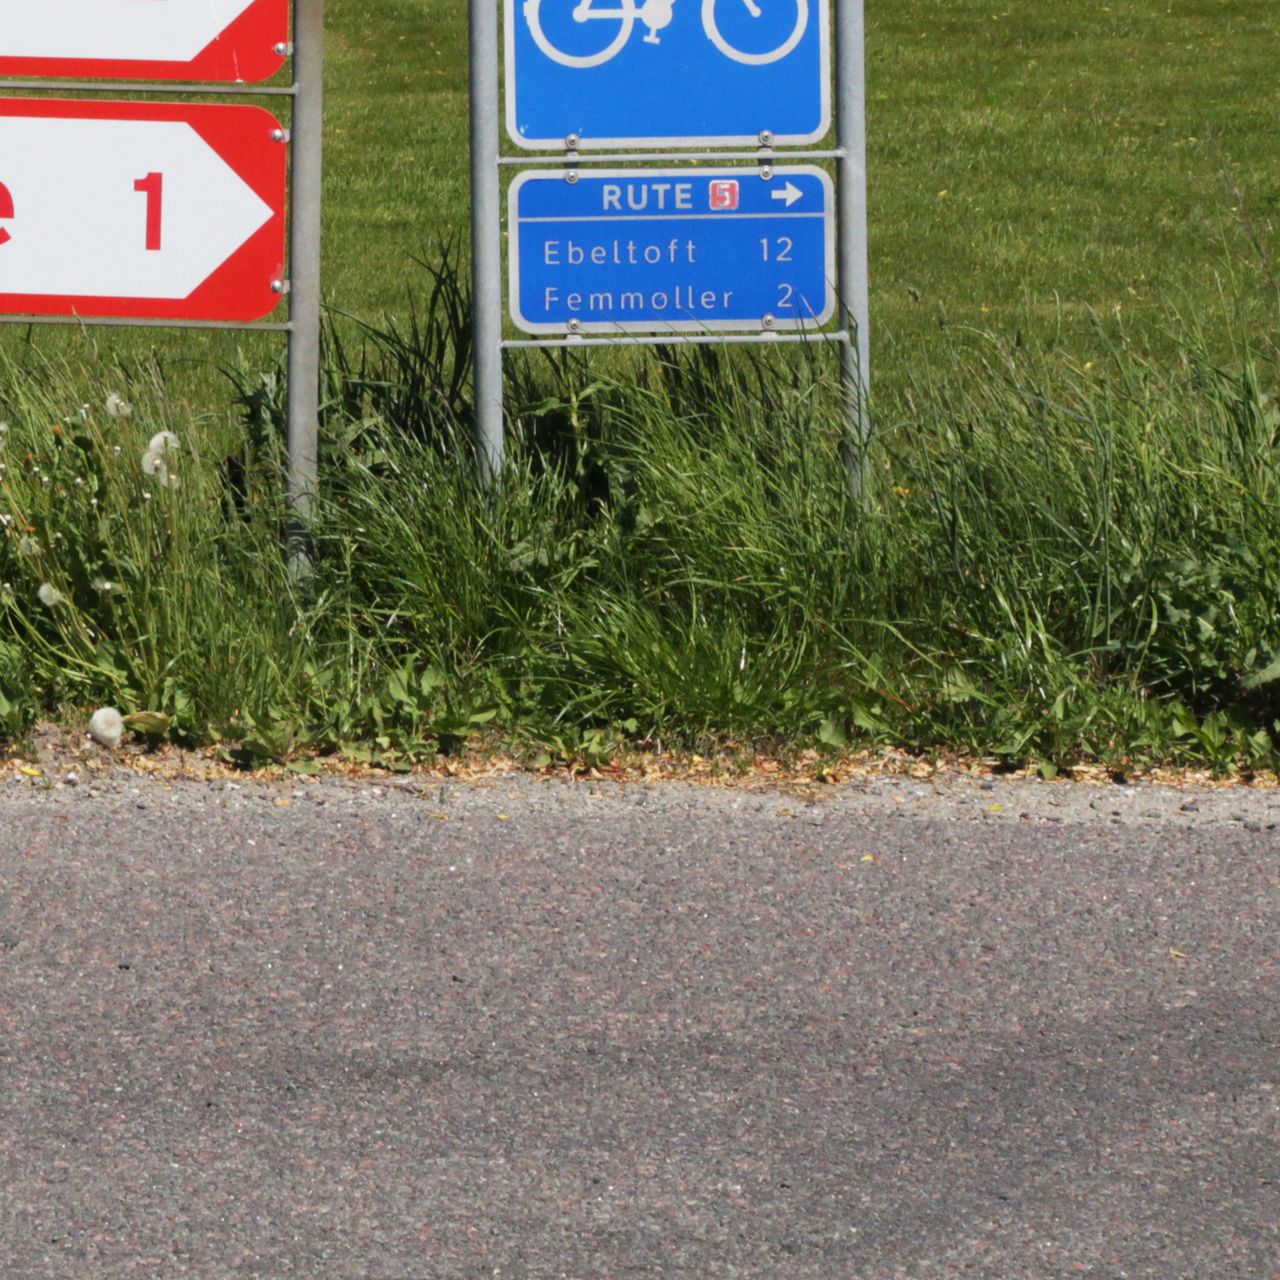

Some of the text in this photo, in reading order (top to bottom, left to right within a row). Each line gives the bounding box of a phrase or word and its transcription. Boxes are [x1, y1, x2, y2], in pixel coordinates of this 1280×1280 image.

[603, 183, 693, 210] RUTE
[133, 171, 163, 251] 1
[544, 236, 793, 265] Ebeltoft 12
[776, 283, 793, 308] 2
